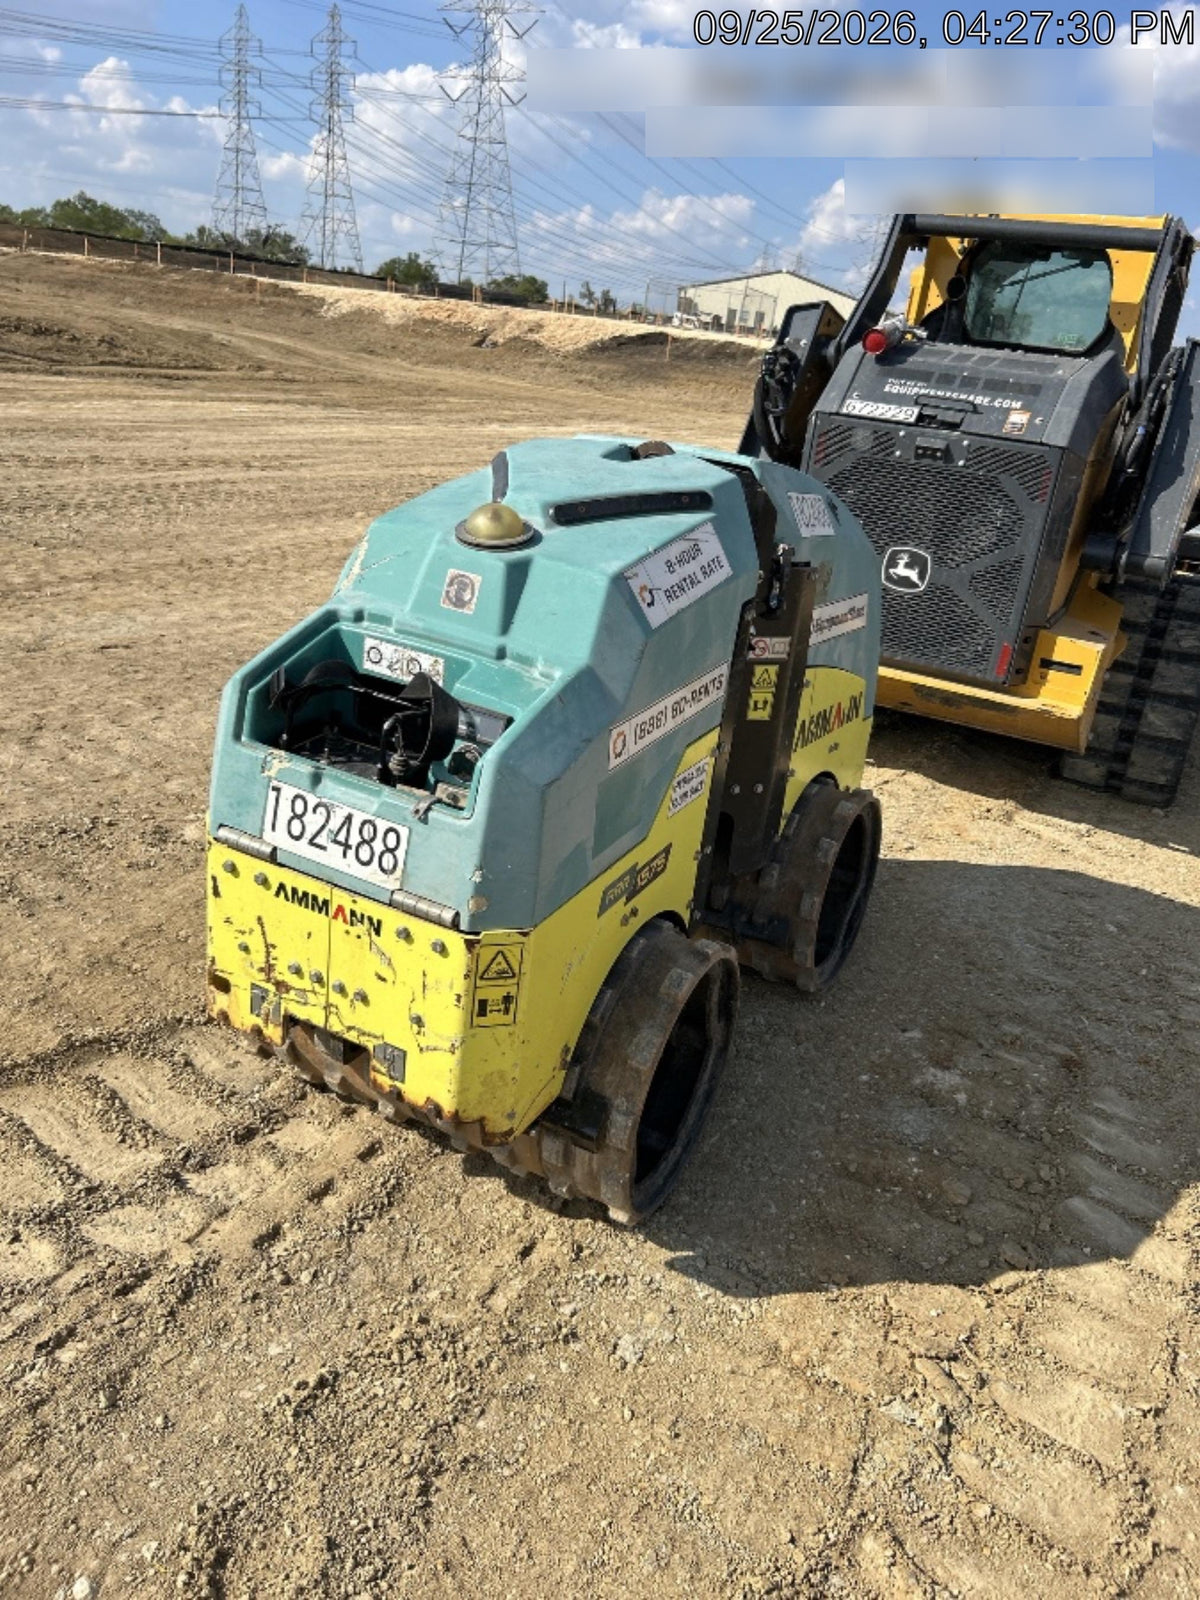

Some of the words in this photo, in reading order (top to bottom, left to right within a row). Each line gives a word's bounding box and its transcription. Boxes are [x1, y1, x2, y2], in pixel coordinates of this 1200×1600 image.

[663, 572, 702, 604] RENTAL
[699, 555, 724, 580] RATE
[664, 543, 702, 575] 8-HOUR
[271, 785, 401, 875] 182488
[274, 882, 382, 937] AMMANN
